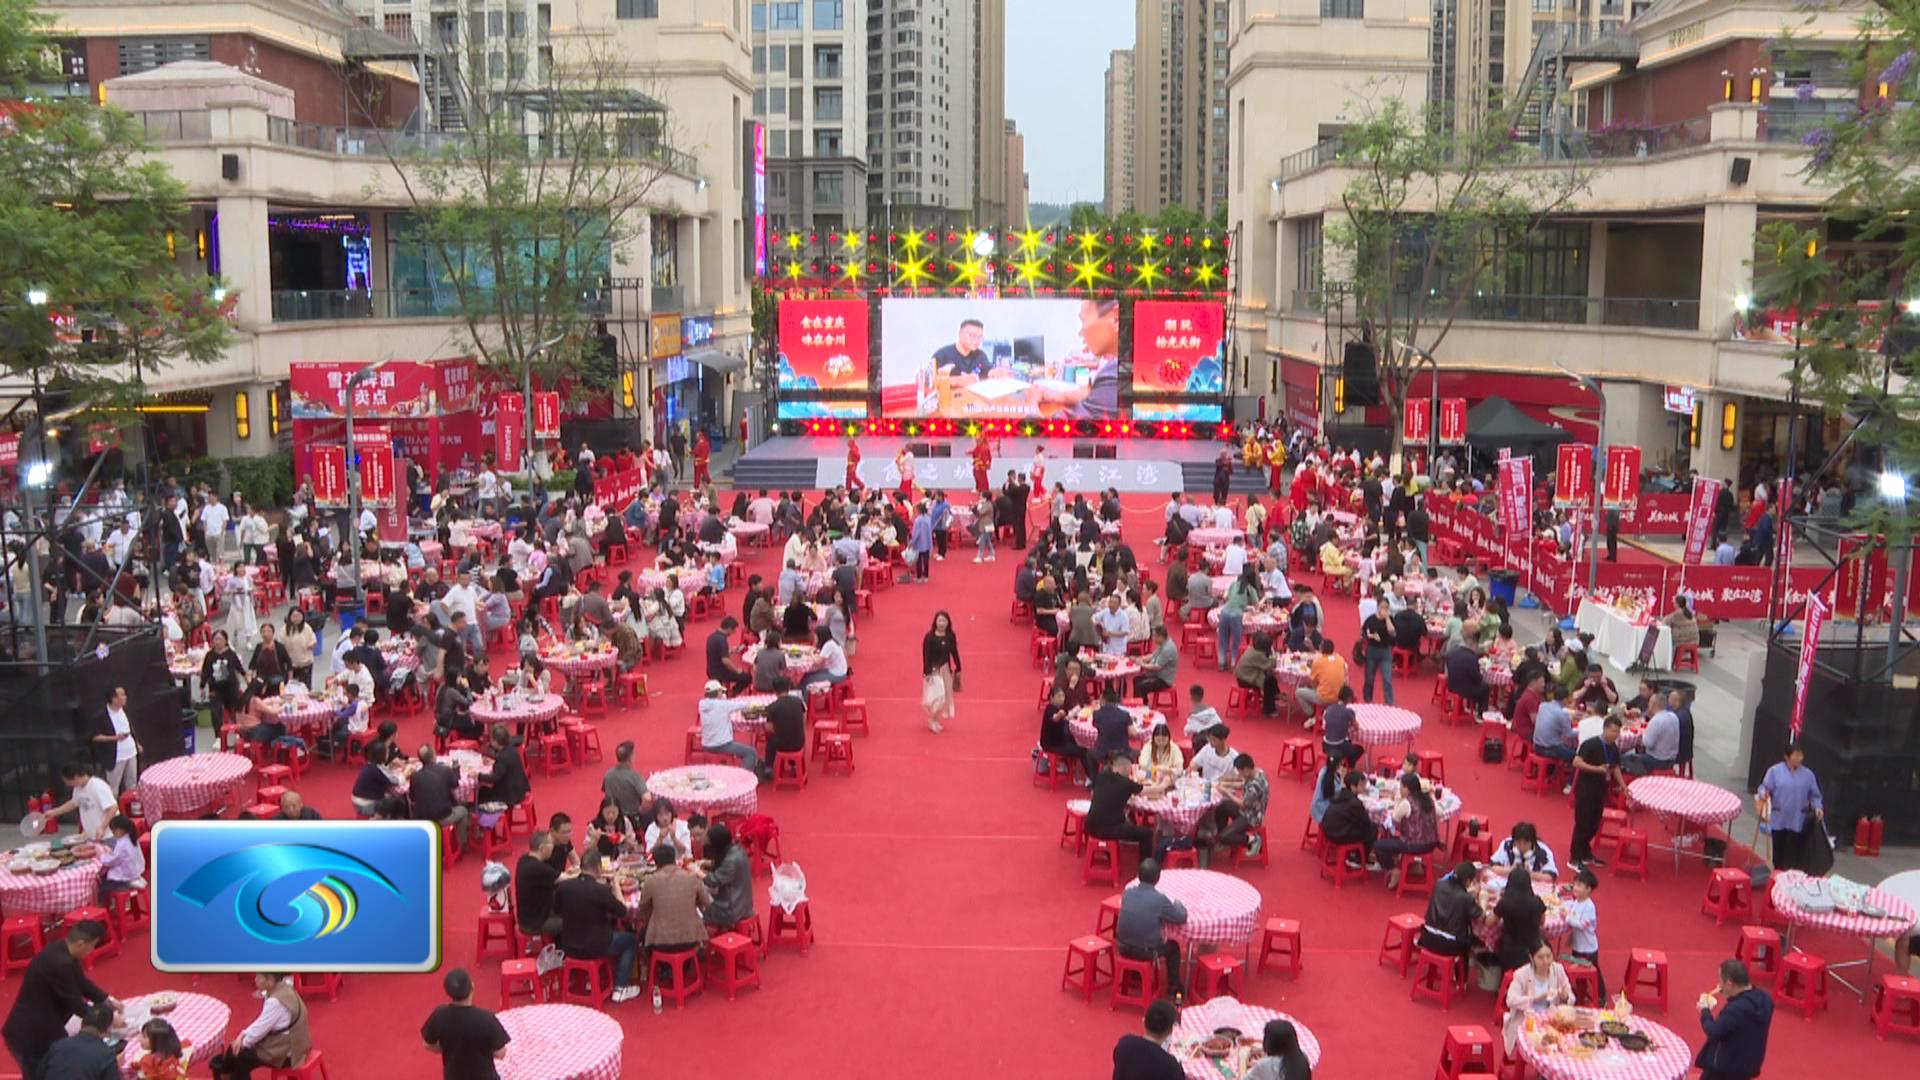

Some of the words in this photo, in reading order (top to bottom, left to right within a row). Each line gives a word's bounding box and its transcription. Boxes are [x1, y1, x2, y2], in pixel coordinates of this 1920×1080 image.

[801, 314, 846, 329] 食在重庆
[801, 333, 846, 347] 味在合川
